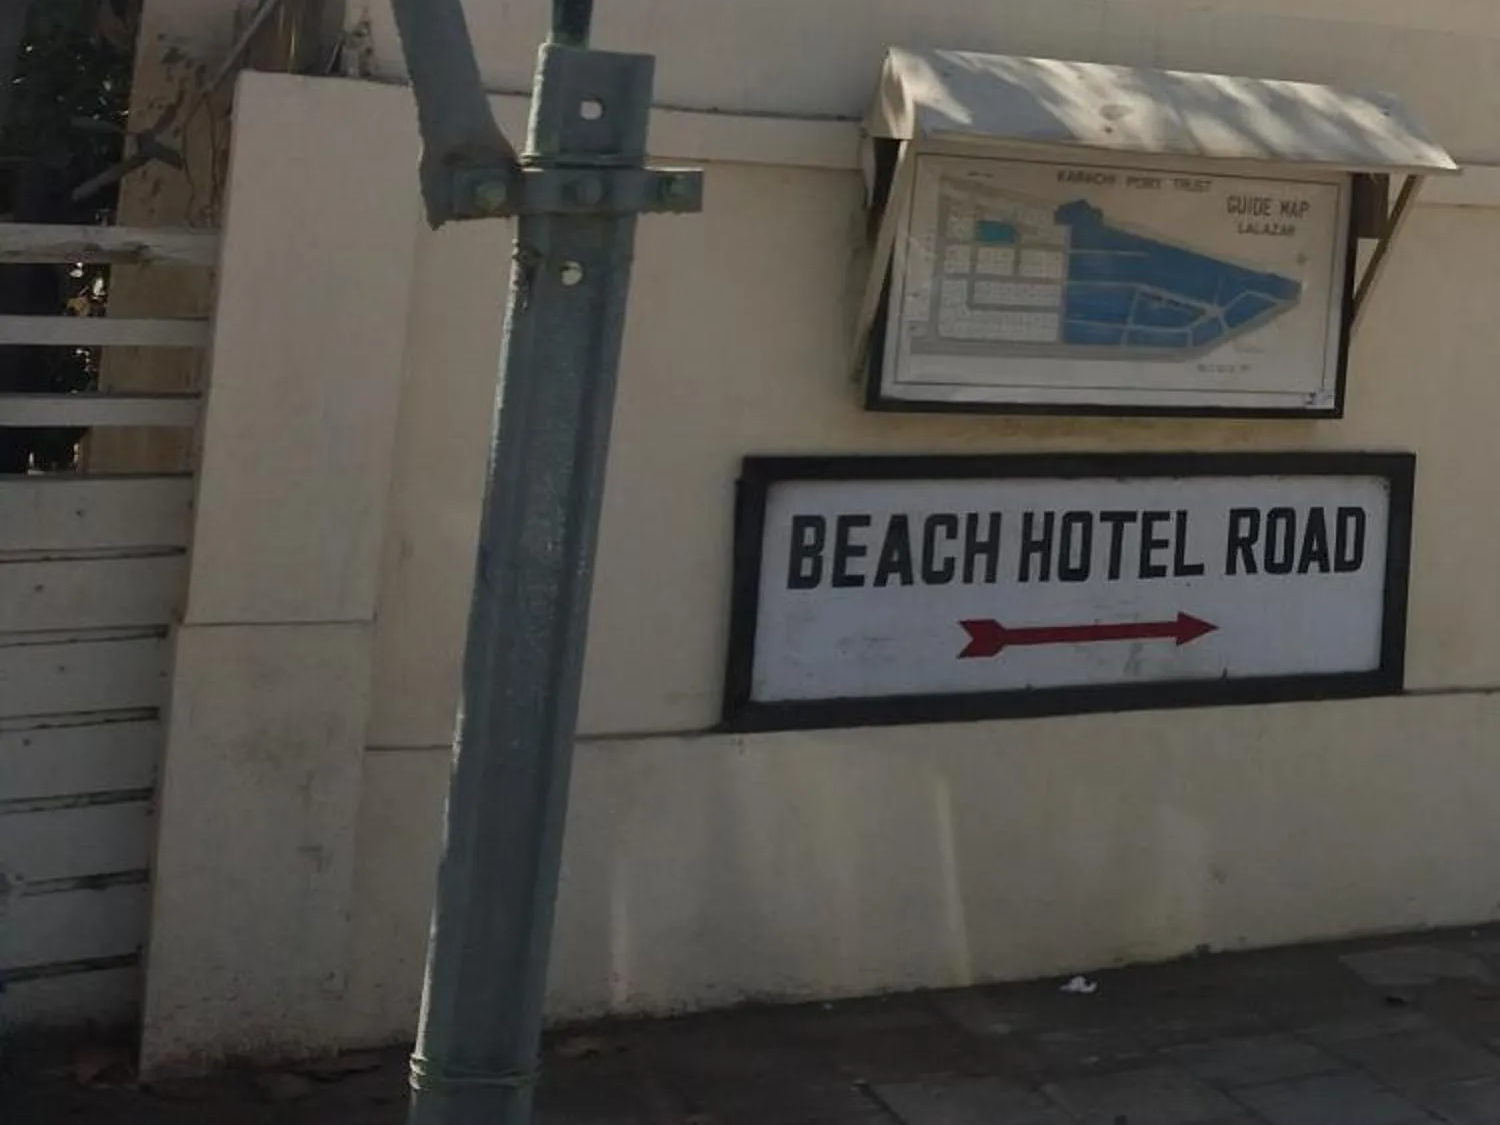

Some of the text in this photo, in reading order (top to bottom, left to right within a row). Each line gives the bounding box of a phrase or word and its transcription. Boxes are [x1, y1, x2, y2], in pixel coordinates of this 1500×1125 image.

[1126, 174, 1162, 190] PORT
[1173, 177, 1213, 193] TRUST
[1226, 194, 1311, 219] GUIDE MAP
[1236, 222, 1297, 237] LALAZAR
[785, 505, 1368, 590] BEACH HOTEL ROAD
